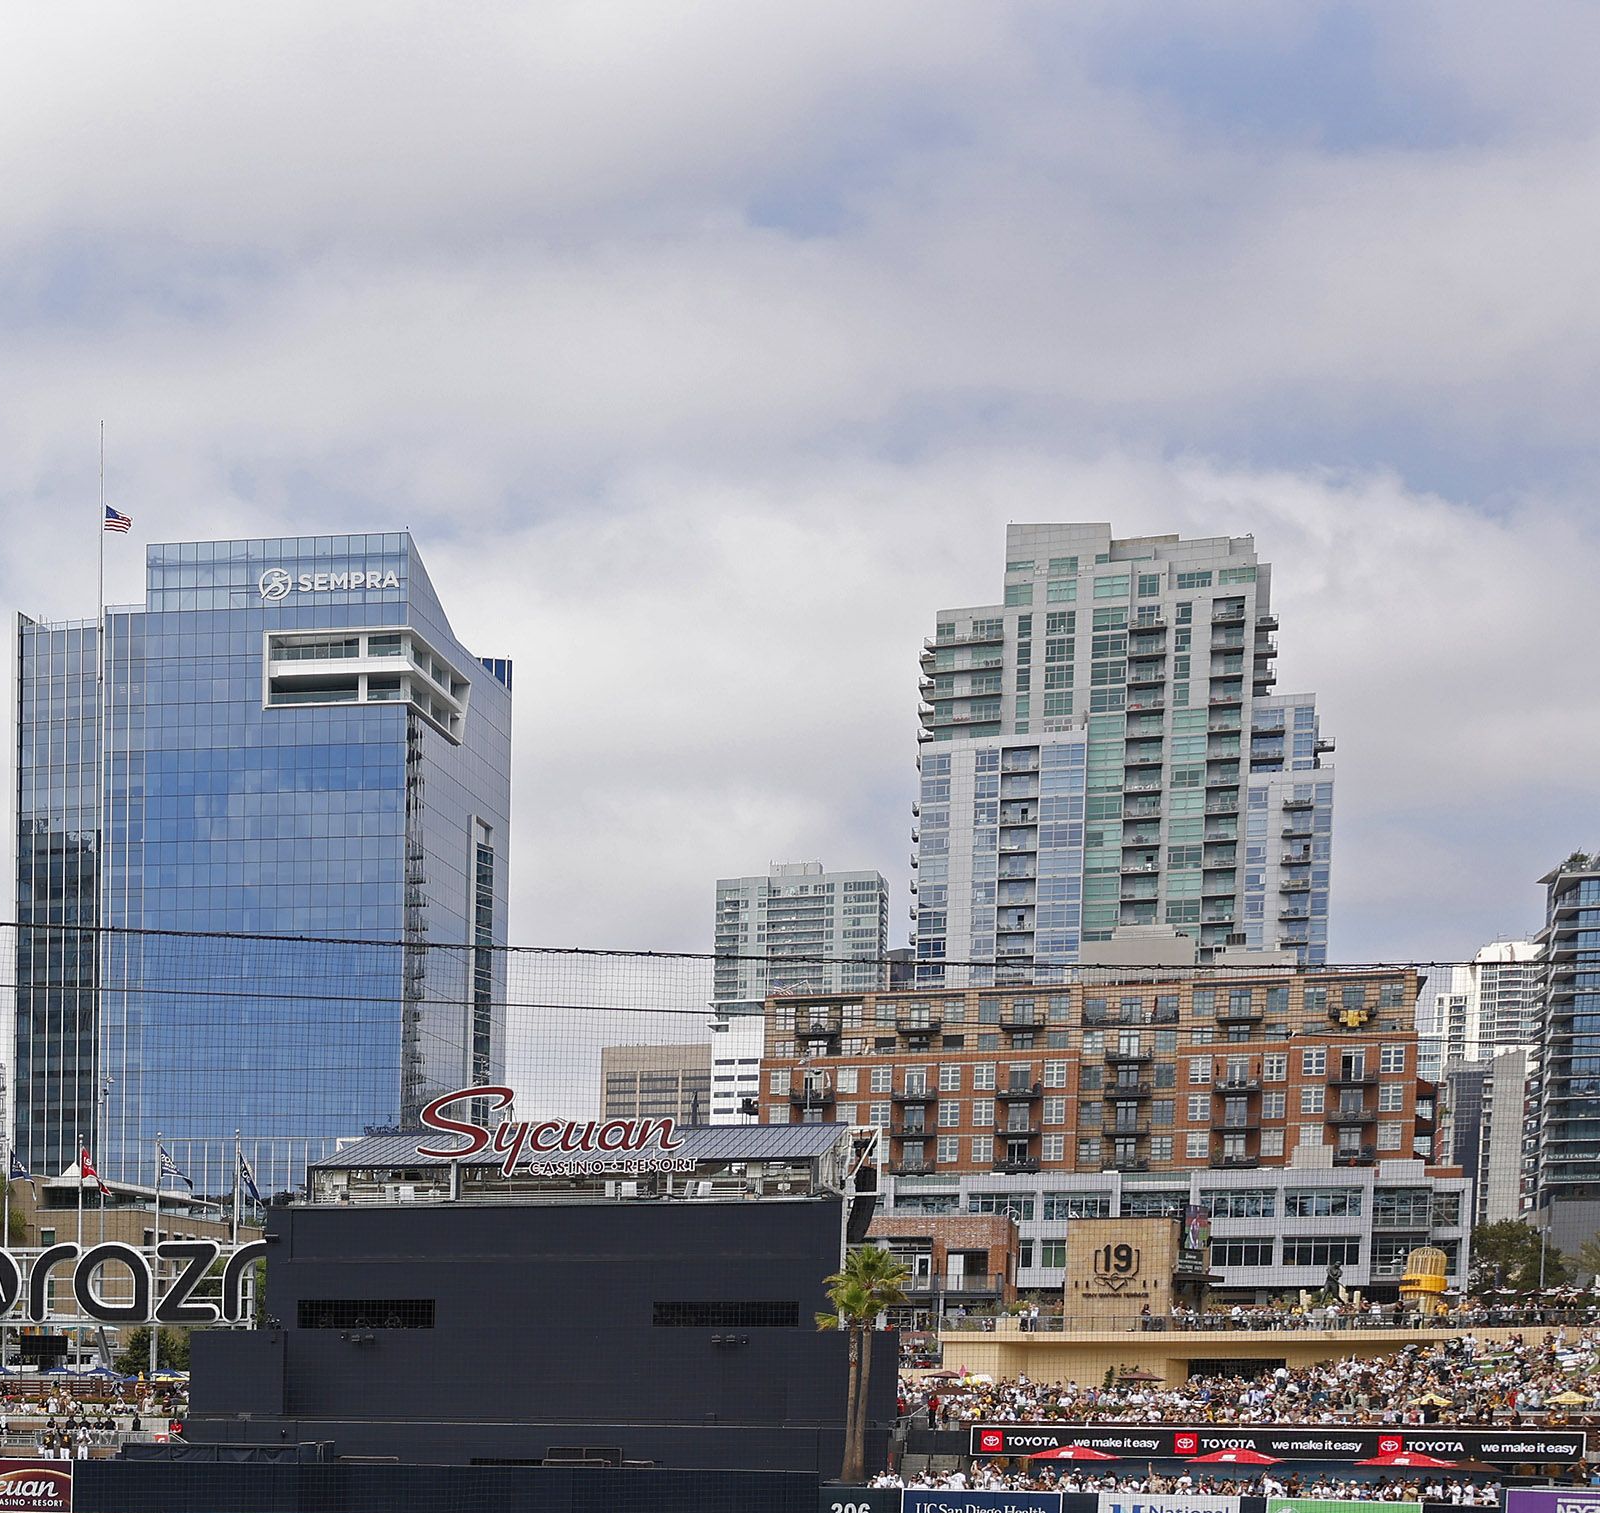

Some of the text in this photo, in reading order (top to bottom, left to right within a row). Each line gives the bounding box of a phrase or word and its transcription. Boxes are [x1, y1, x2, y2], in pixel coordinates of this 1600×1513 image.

[299, 570, 400, 592] SEMPRA
[416, 1085, 686, 1178] Sycuan
[529, 1156, 699, 1175] CASINO RESORT
[1104, 1243, 1133, 1273] 19
[29, 1240, 267, 1324] razr
[1007, 1436, 1159, 1450] TOYOTA we make it easy
[1201, 1438, 1362, 1452] TOYOTA we make it easy
[1406, 1441, 1576, 1454] TOYOTA we make it easy
[32, 1498, 64, 1508] RESORT
